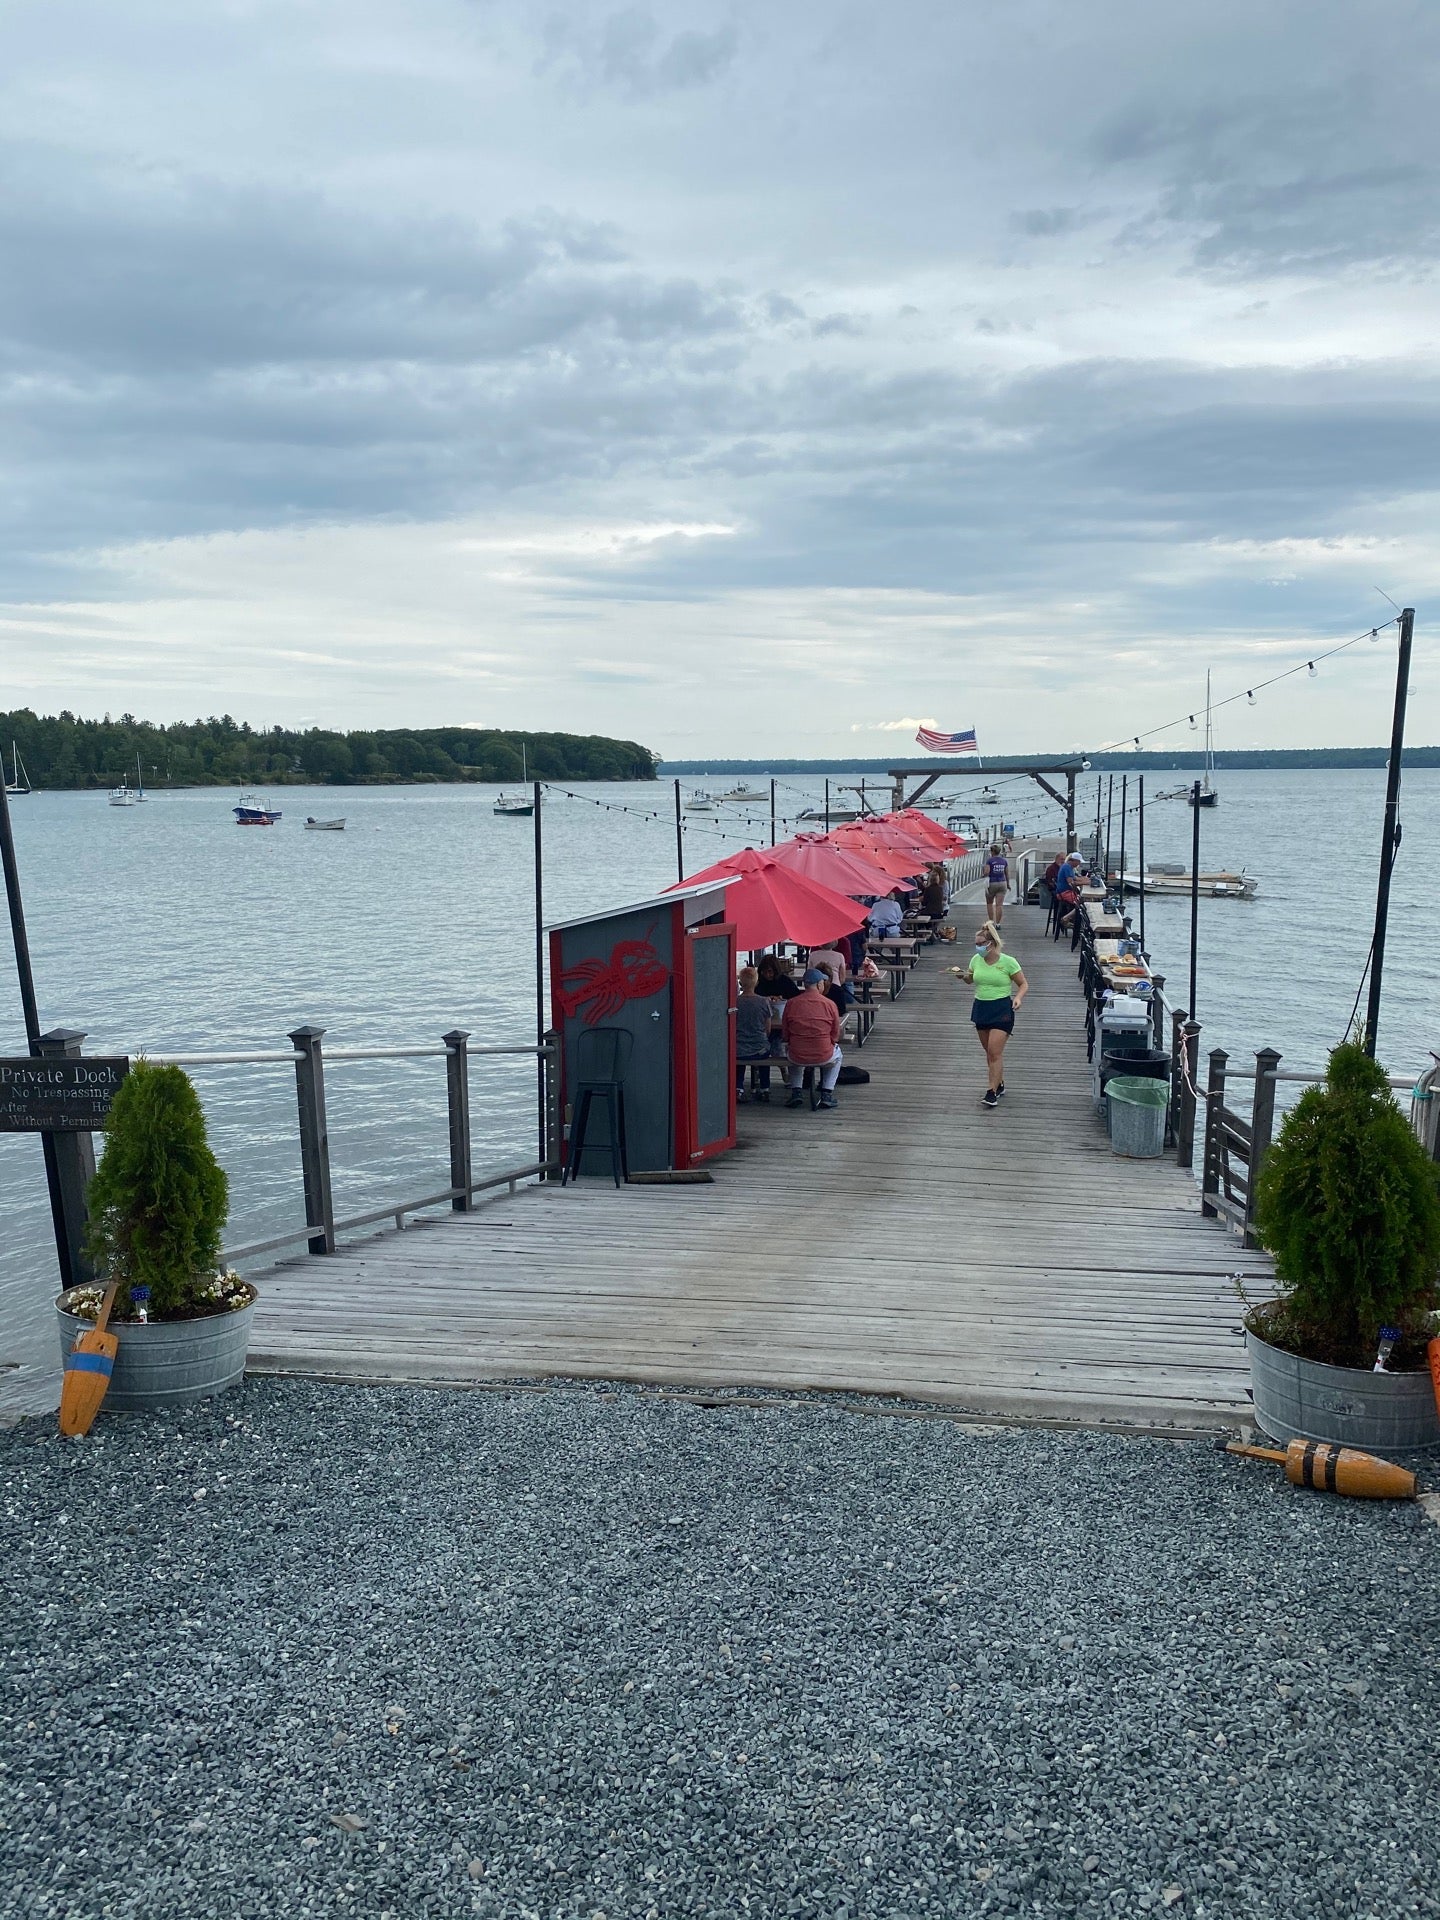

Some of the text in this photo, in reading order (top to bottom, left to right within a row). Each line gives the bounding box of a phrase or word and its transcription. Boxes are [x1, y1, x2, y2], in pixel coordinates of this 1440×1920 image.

[0, 1066, 118, 1084] Private Dock
[11, 1084, 112, 1102] No Trespassing
[0, 1101, 28, 1113] After
[92, 1101, 114, 1112] Hou
[8, 1115, 105, 1127] Without Permiss
